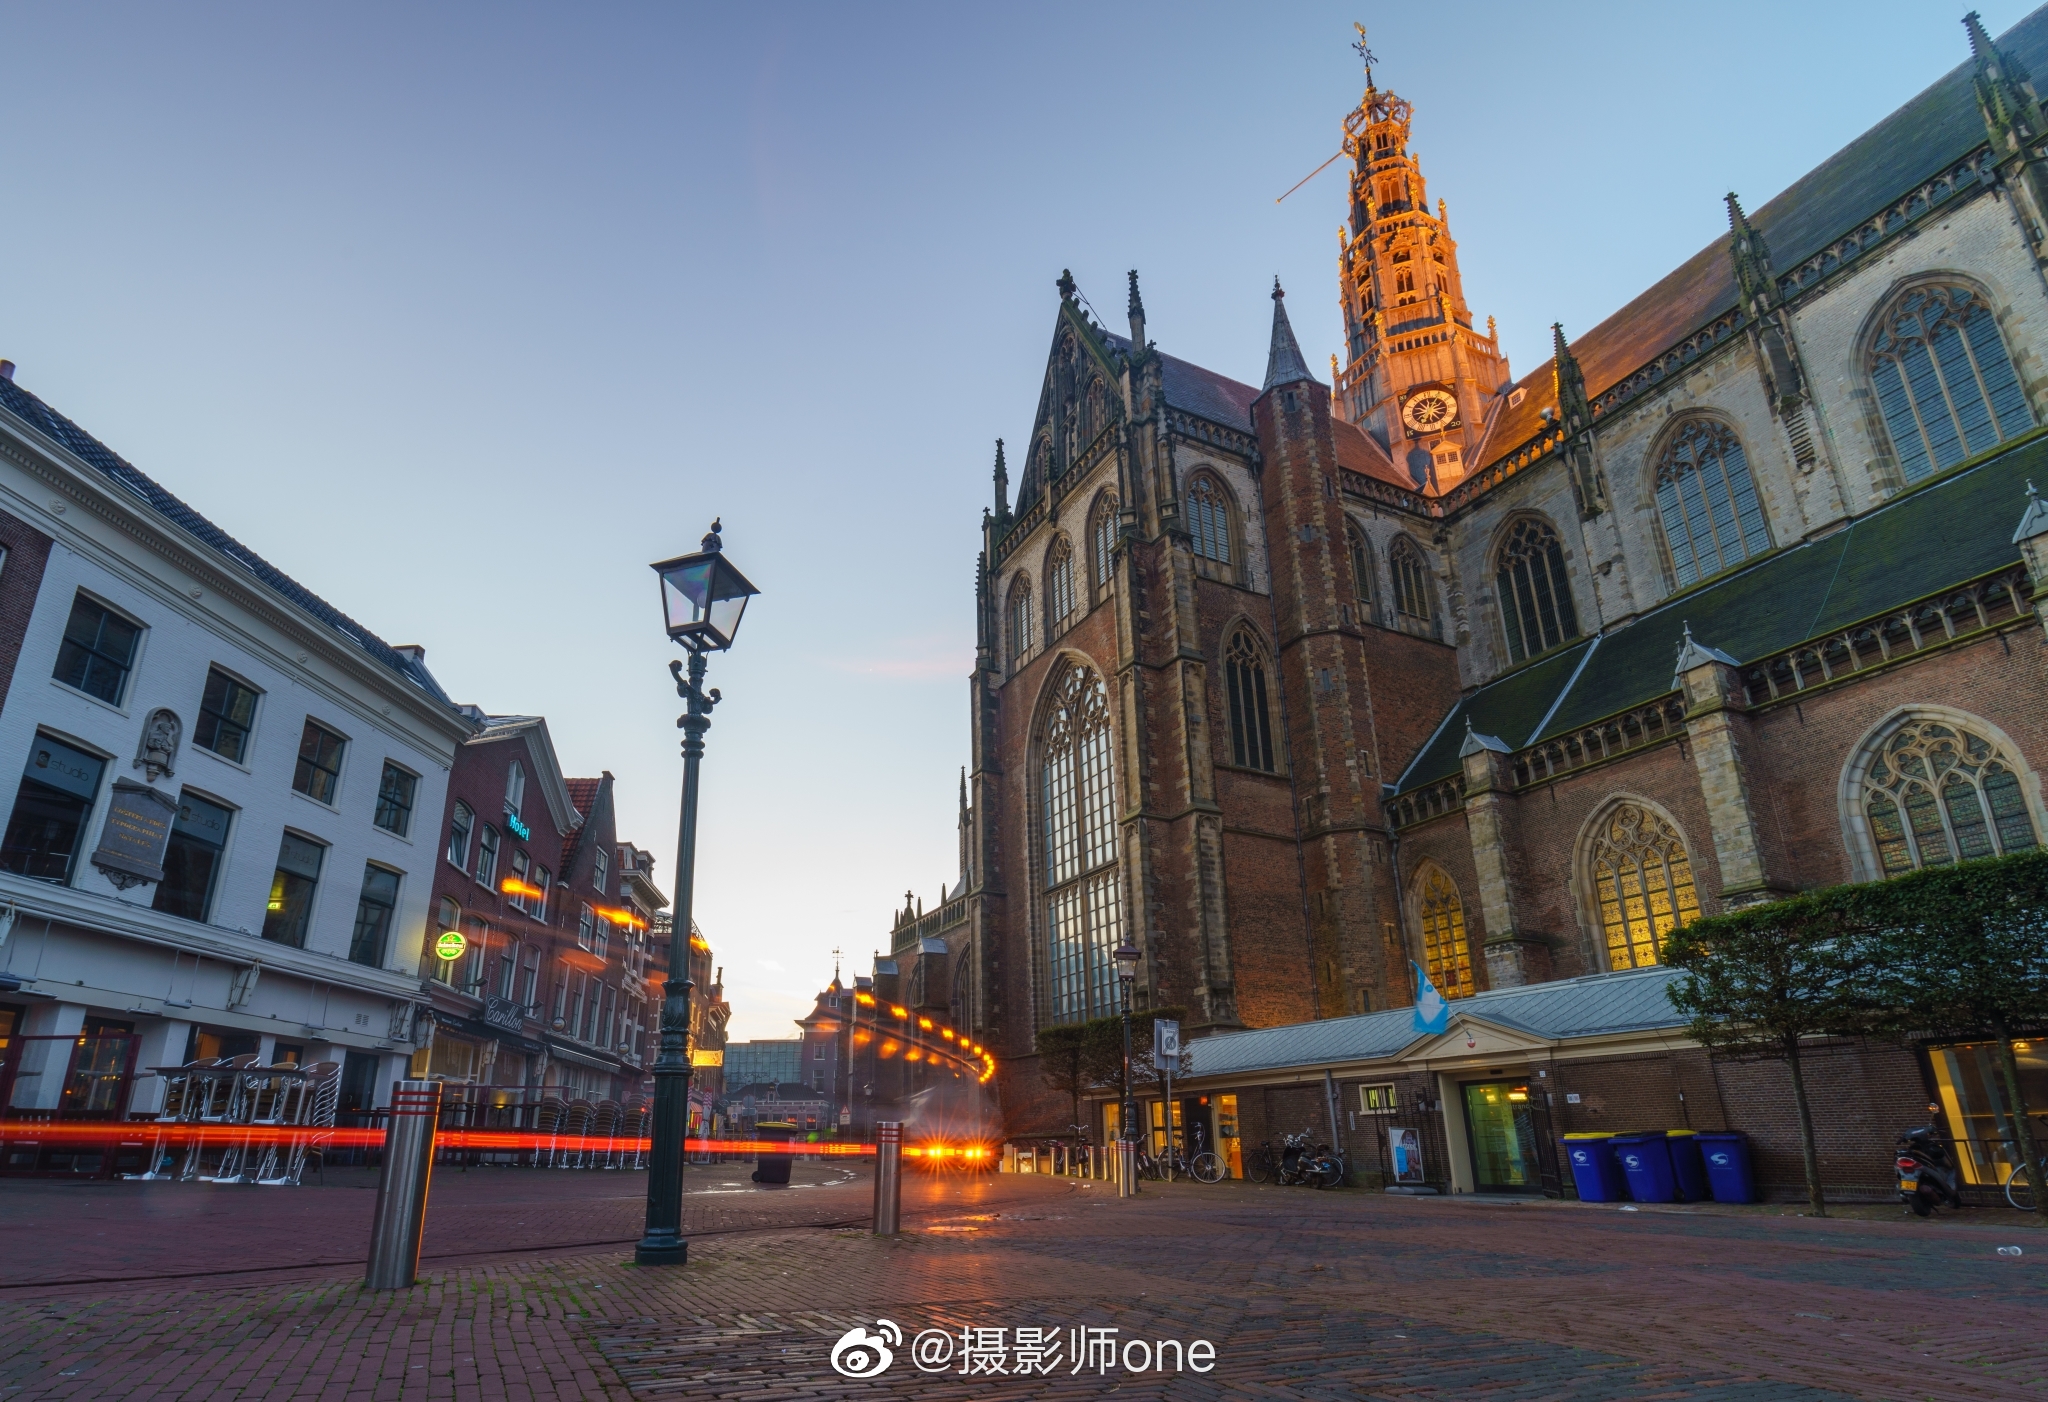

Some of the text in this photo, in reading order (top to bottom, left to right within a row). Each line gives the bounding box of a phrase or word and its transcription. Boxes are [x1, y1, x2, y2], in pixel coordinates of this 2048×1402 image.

[50, 760, 89, 781] studio
[190, 813, 220, 831] studio
[510, 814, 530, 841] Hotel
[487, 997, 524, 1031] Carillon
